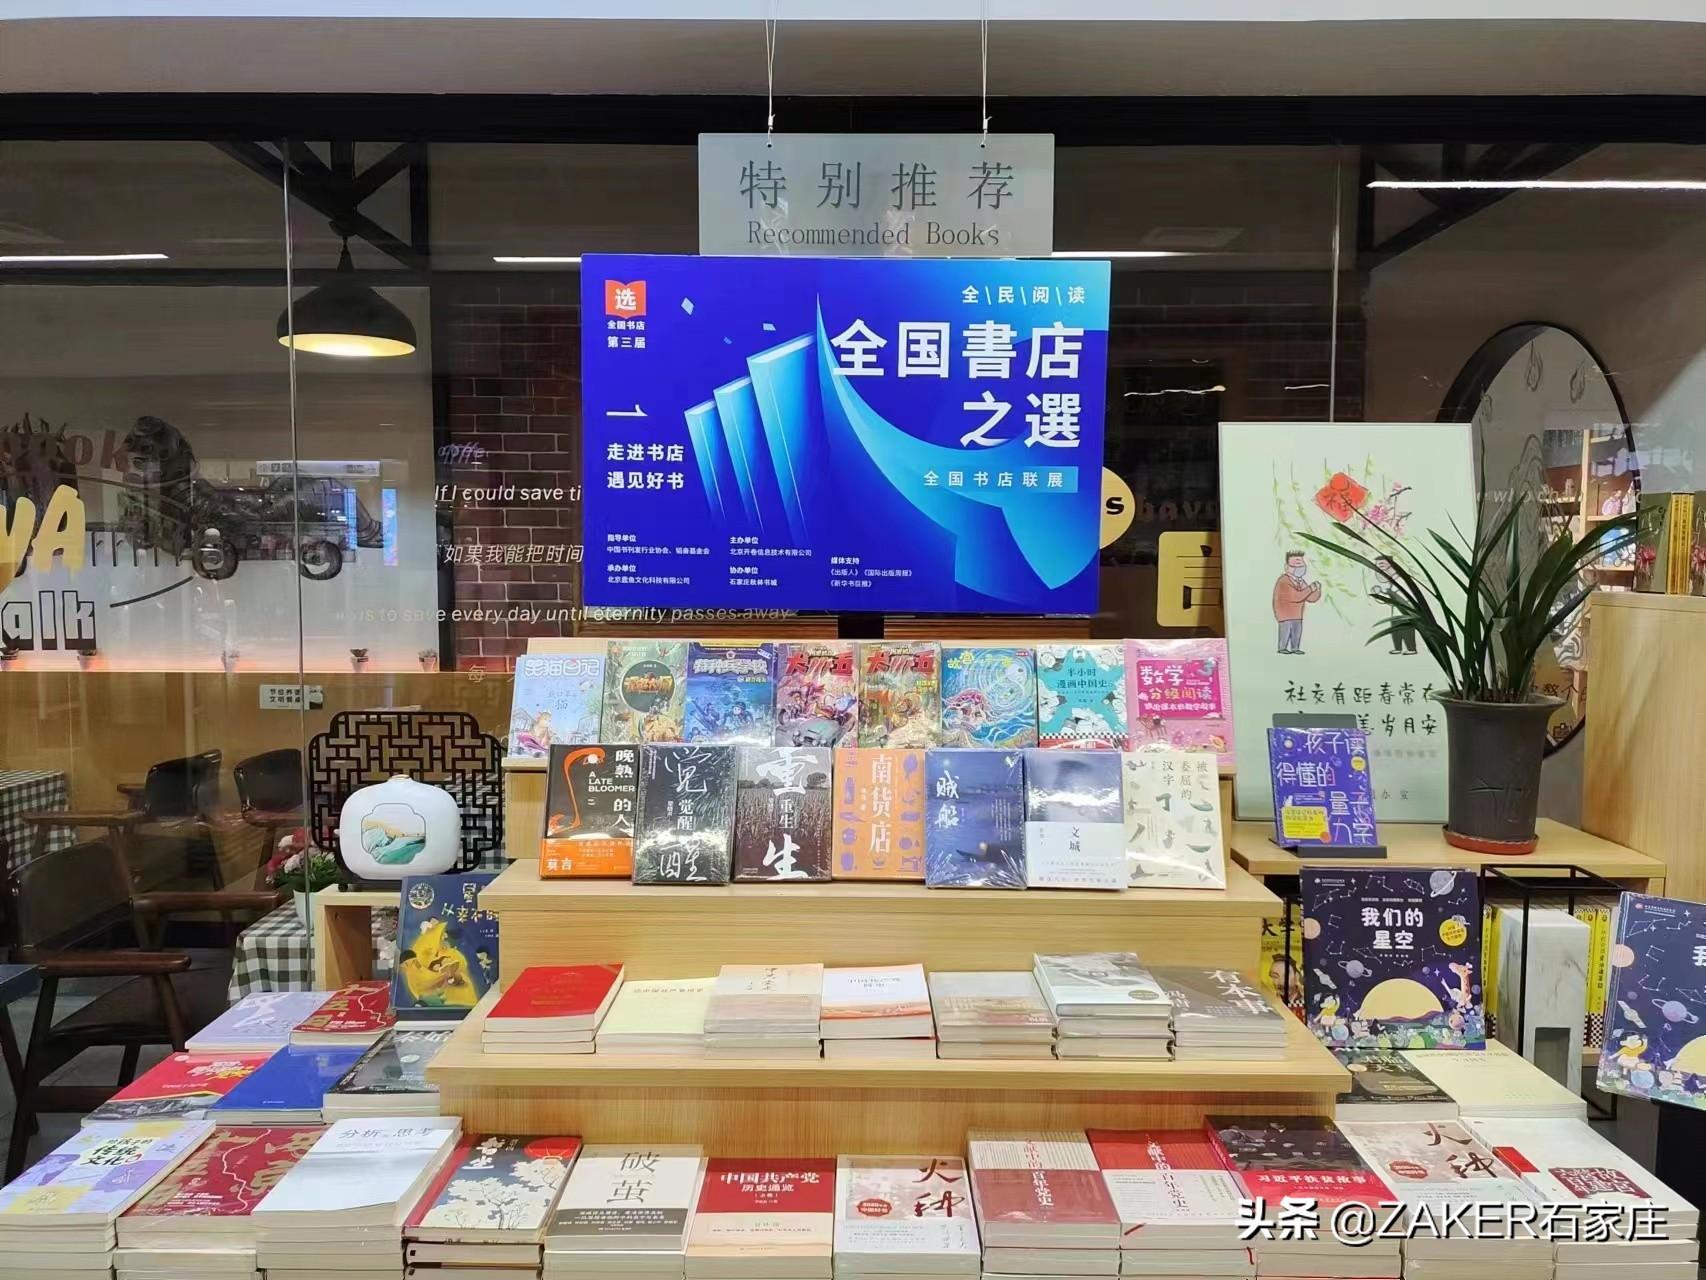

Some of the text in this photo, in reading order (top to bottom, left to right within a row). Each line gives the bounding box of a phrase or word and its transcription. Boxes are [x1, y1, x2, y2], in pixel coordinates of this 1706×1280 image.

[739, 160, 1015, 210] 特别推荐
[747, 220, 1000, 247] Recommended Books
[615, 287, 638, 311] 选
[606, 319, 646, 331] 全国书店
[606, 335, 647, 349] 第三届
[831, 319, 1084, 379] 全国書店
[959, 391, 1082, 449] 之選
[606, 443, 685, 462] 走进书店
[606, 471, 685, 490] 遇见好书
[922, 470, 1064, 488] 全国书店联展
[462, 484, 515, 501] could
[519, 488, 564, 501] save
[607, 533, 637, 543] 指导单位
[729, 536, 759, 545] 主办单位
[444, 543, 584, 565] 如果我能把时间
[830, 557, 860, 566] 媒体支持
[607, 564, 637, 573] 承办单位
[729, 566, 759, 575] 协办单位
[451, 609, 503, 625] every
[512, 606, 542, 625] day
[546, 606, 588, 621] until
[593, 605, 667, 624] eternity
[671, 607, 738, 624] passes
[523, 657, 601, 678] 笑猫日记
[1067, 667, 1097, 678] 半小时
[1139, 664, 1185, 686] 数学
[588, 770, 597, 778] A
[588, 777, 613, 785] LATE
[588, 784, 636, 793] BLOOMER
[612, 749, 636, 829] 晚熟的人
[869, 753, 894, 855] 南货店
[778, 798, 796, 830] 重生
[1360, 906, 1424, 928] 我们的
[1372, 929, 1415, 950] 星空
[92, 1144, 140, 1155] 传统
[80, 1155, 124, 1166] 文化
[606, 1151, 660, 1205] 破茧
[720, 1171, 820, 1185] 中国共产党
[1256, 1174, 1367, 1185] 习近平扶贫故事
[741, 1183, 795, 1193] 历史通览
[912, 1158, 966, 1218] 火种
